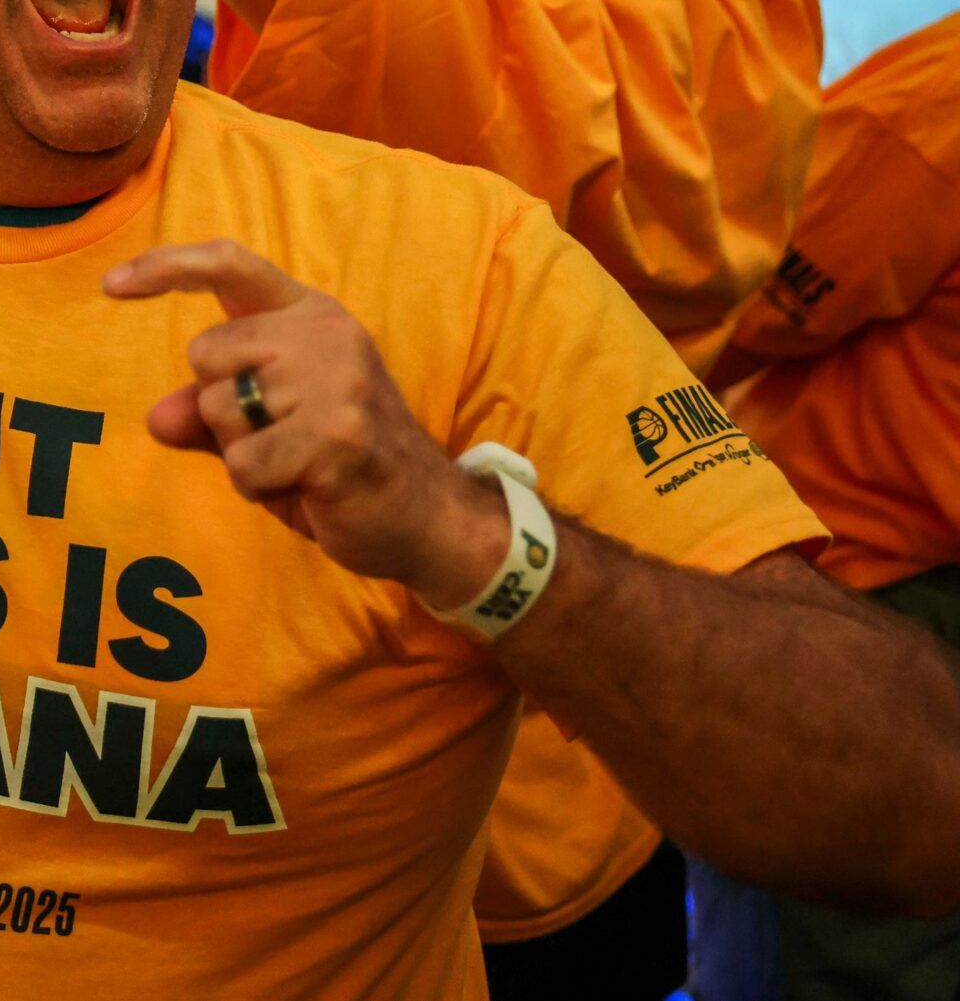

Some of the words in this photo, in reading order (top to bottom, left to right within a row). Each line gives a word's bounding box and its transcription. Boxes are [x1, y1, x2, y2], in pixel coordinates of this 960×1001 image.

[655, 384, 737, 443] FINAL
[655, 468, 698, 496] KeyBank
[57, 543, 207, 682] IS
